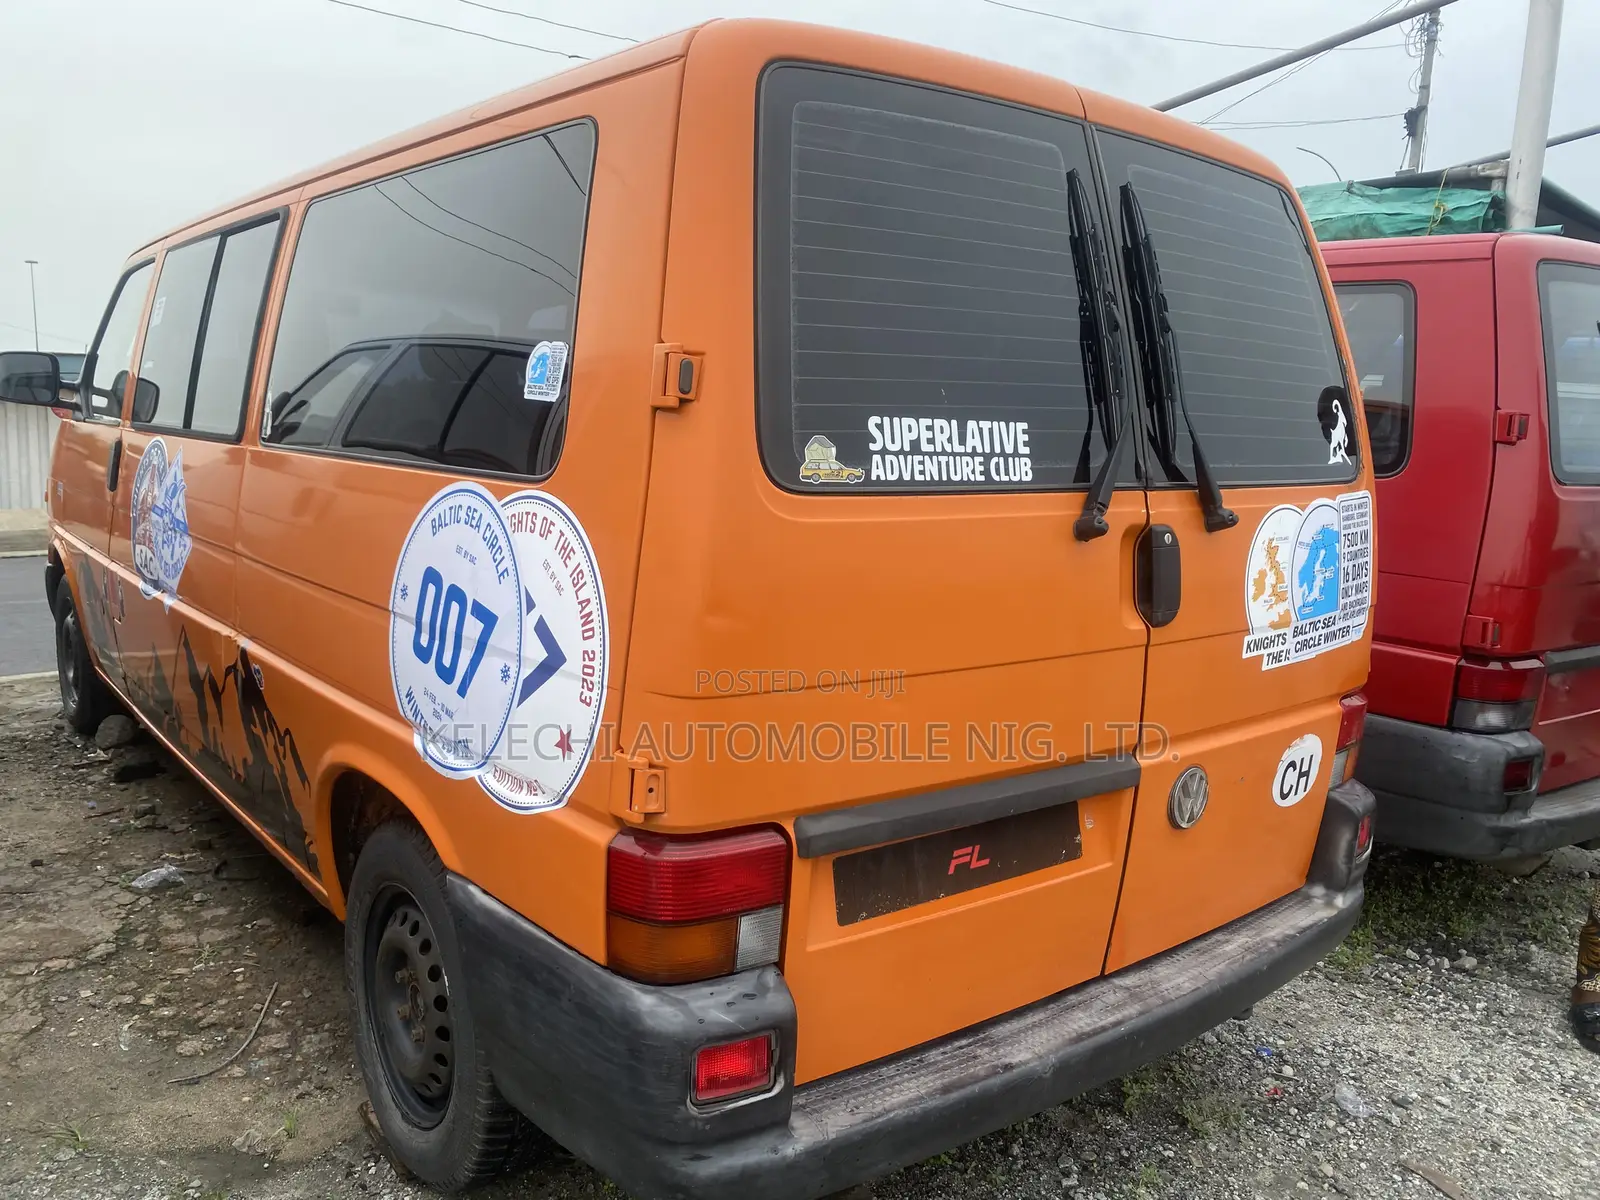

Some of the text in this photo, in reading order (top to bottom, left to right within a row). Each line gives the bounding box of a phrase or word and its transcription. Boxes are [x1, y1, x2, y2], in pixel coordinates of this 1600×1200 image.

[868, 415, 1031, 454] SUPERLATIVE
[870, 454, 1033, 482] ADVENTURE CLUB
[431, 504, 510, 585] BALTIC SEA CIRCLE
[1343, 529, 1368, 549] 7500 KM
[140, 548, 154, 576] SAC
[1342, 552, 1346, 563] 9
[1342, 566, 1350, 584] 16
[1351, 561, 1368, 582] DAYS
[1341, 580, 1368, 599] ONLY MAPS
[508, 511, 596, 707] GHTS OF THE ISLAND 2023
[413, 566, 499, 699] 007
[1292, 614, 1337, 639] BALTIC SEA
[1294, 625, 1351, 653] CIRCLE WINTER
[1245, 632, 1288, 654] KNIGHTS
[1266, 650, 1285, 666] THE
[1279, 754, 1315, 800] CH
[948, 844, 990, 875] FL
